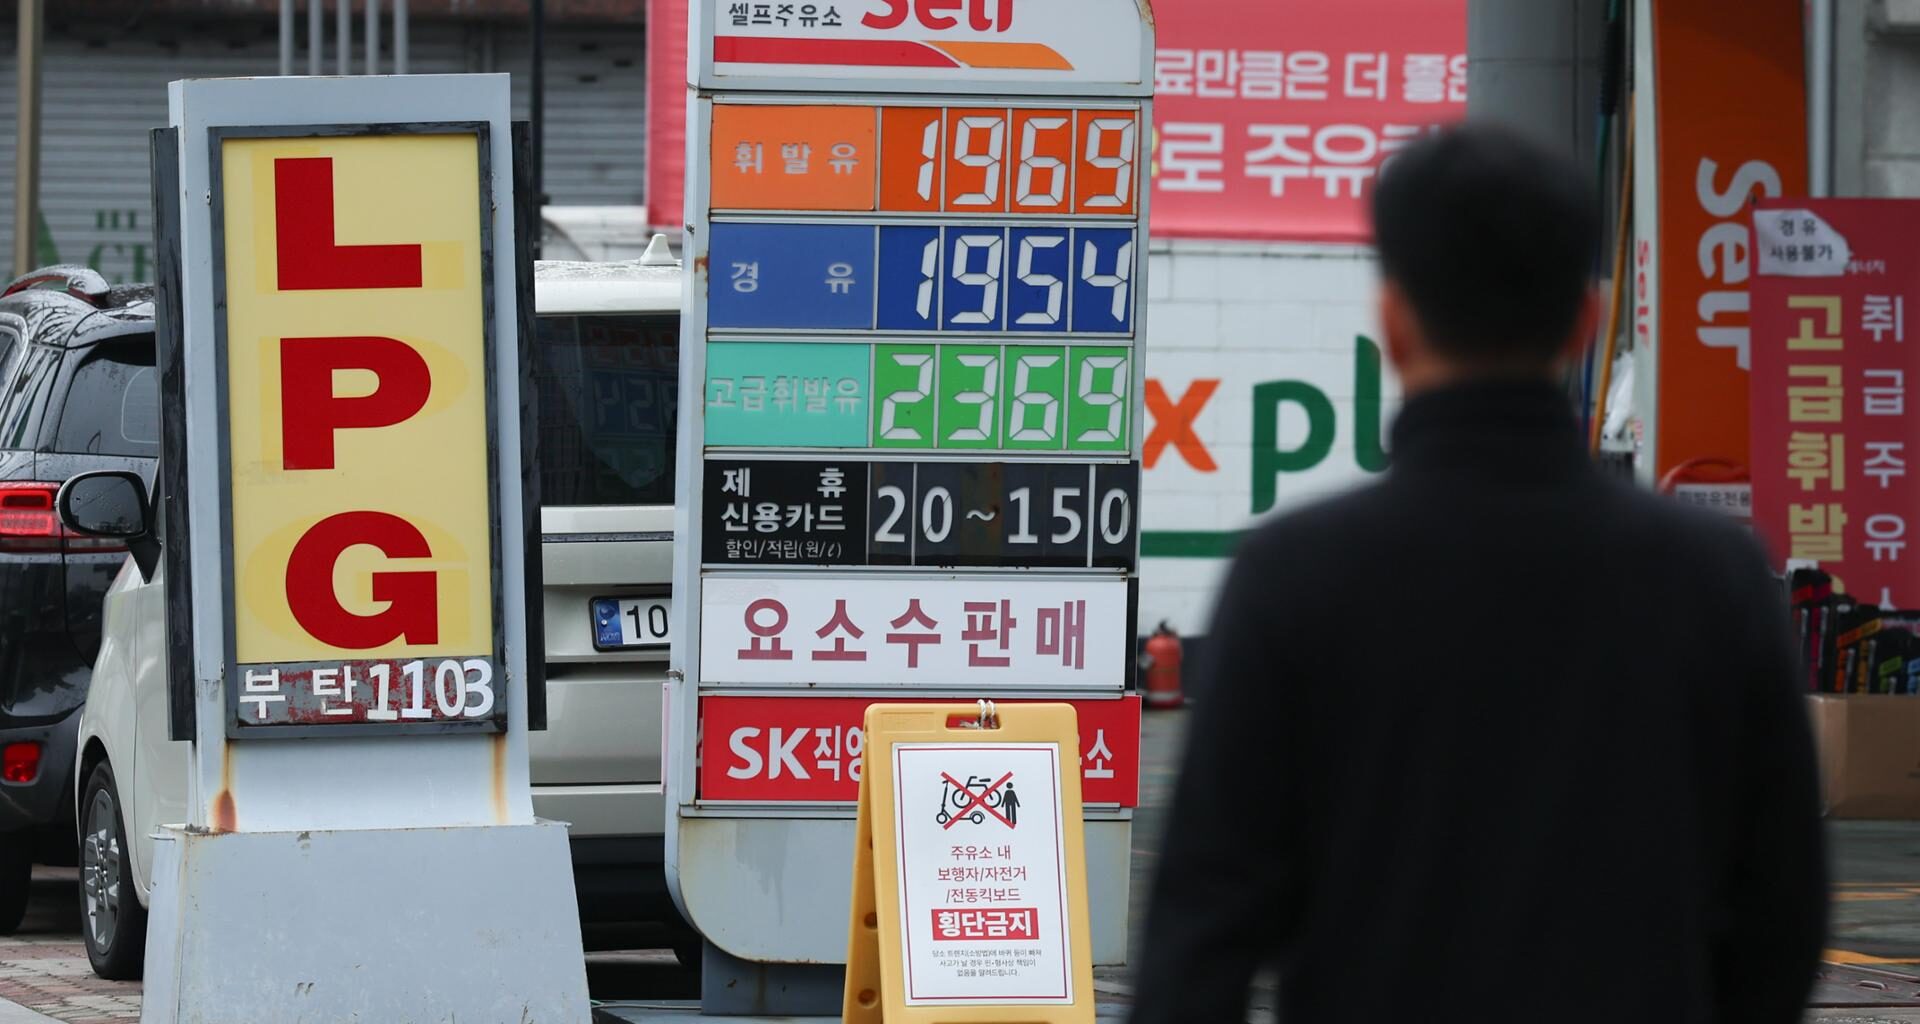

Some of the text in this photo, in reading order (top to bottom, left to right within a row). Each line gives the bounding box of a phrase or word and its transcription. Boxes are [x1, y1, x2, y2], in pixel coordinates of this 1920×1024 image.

[729, 3, 842, 27] 셀프주유소
[1344, 52, 1388, 101] 더
[734, 116, 1135, 207] 휘발유 1969
[1151, 123, 1225, 192] 로
[914, 235, 1133, 324] 1954
[707, 375, 863, 416] 고급휘발유
[879, 353, 1128, 441] 2369
[1786, 296, 1848, 596] 고급휘발
[721, 504, 846, 532] 신용카드
[626, 604, 669, 639] 10
[366, 658, 495, 721] 1103
[1080, 728, 1114, 779] 소
[937, 865, 1027, 883] 보행자/자전거
[951, 844, 1011, 861] 주유소 내
[945, 887, 1021, 904] /전동킥보드
[937, 910, 1032, 937] 횡단금지
